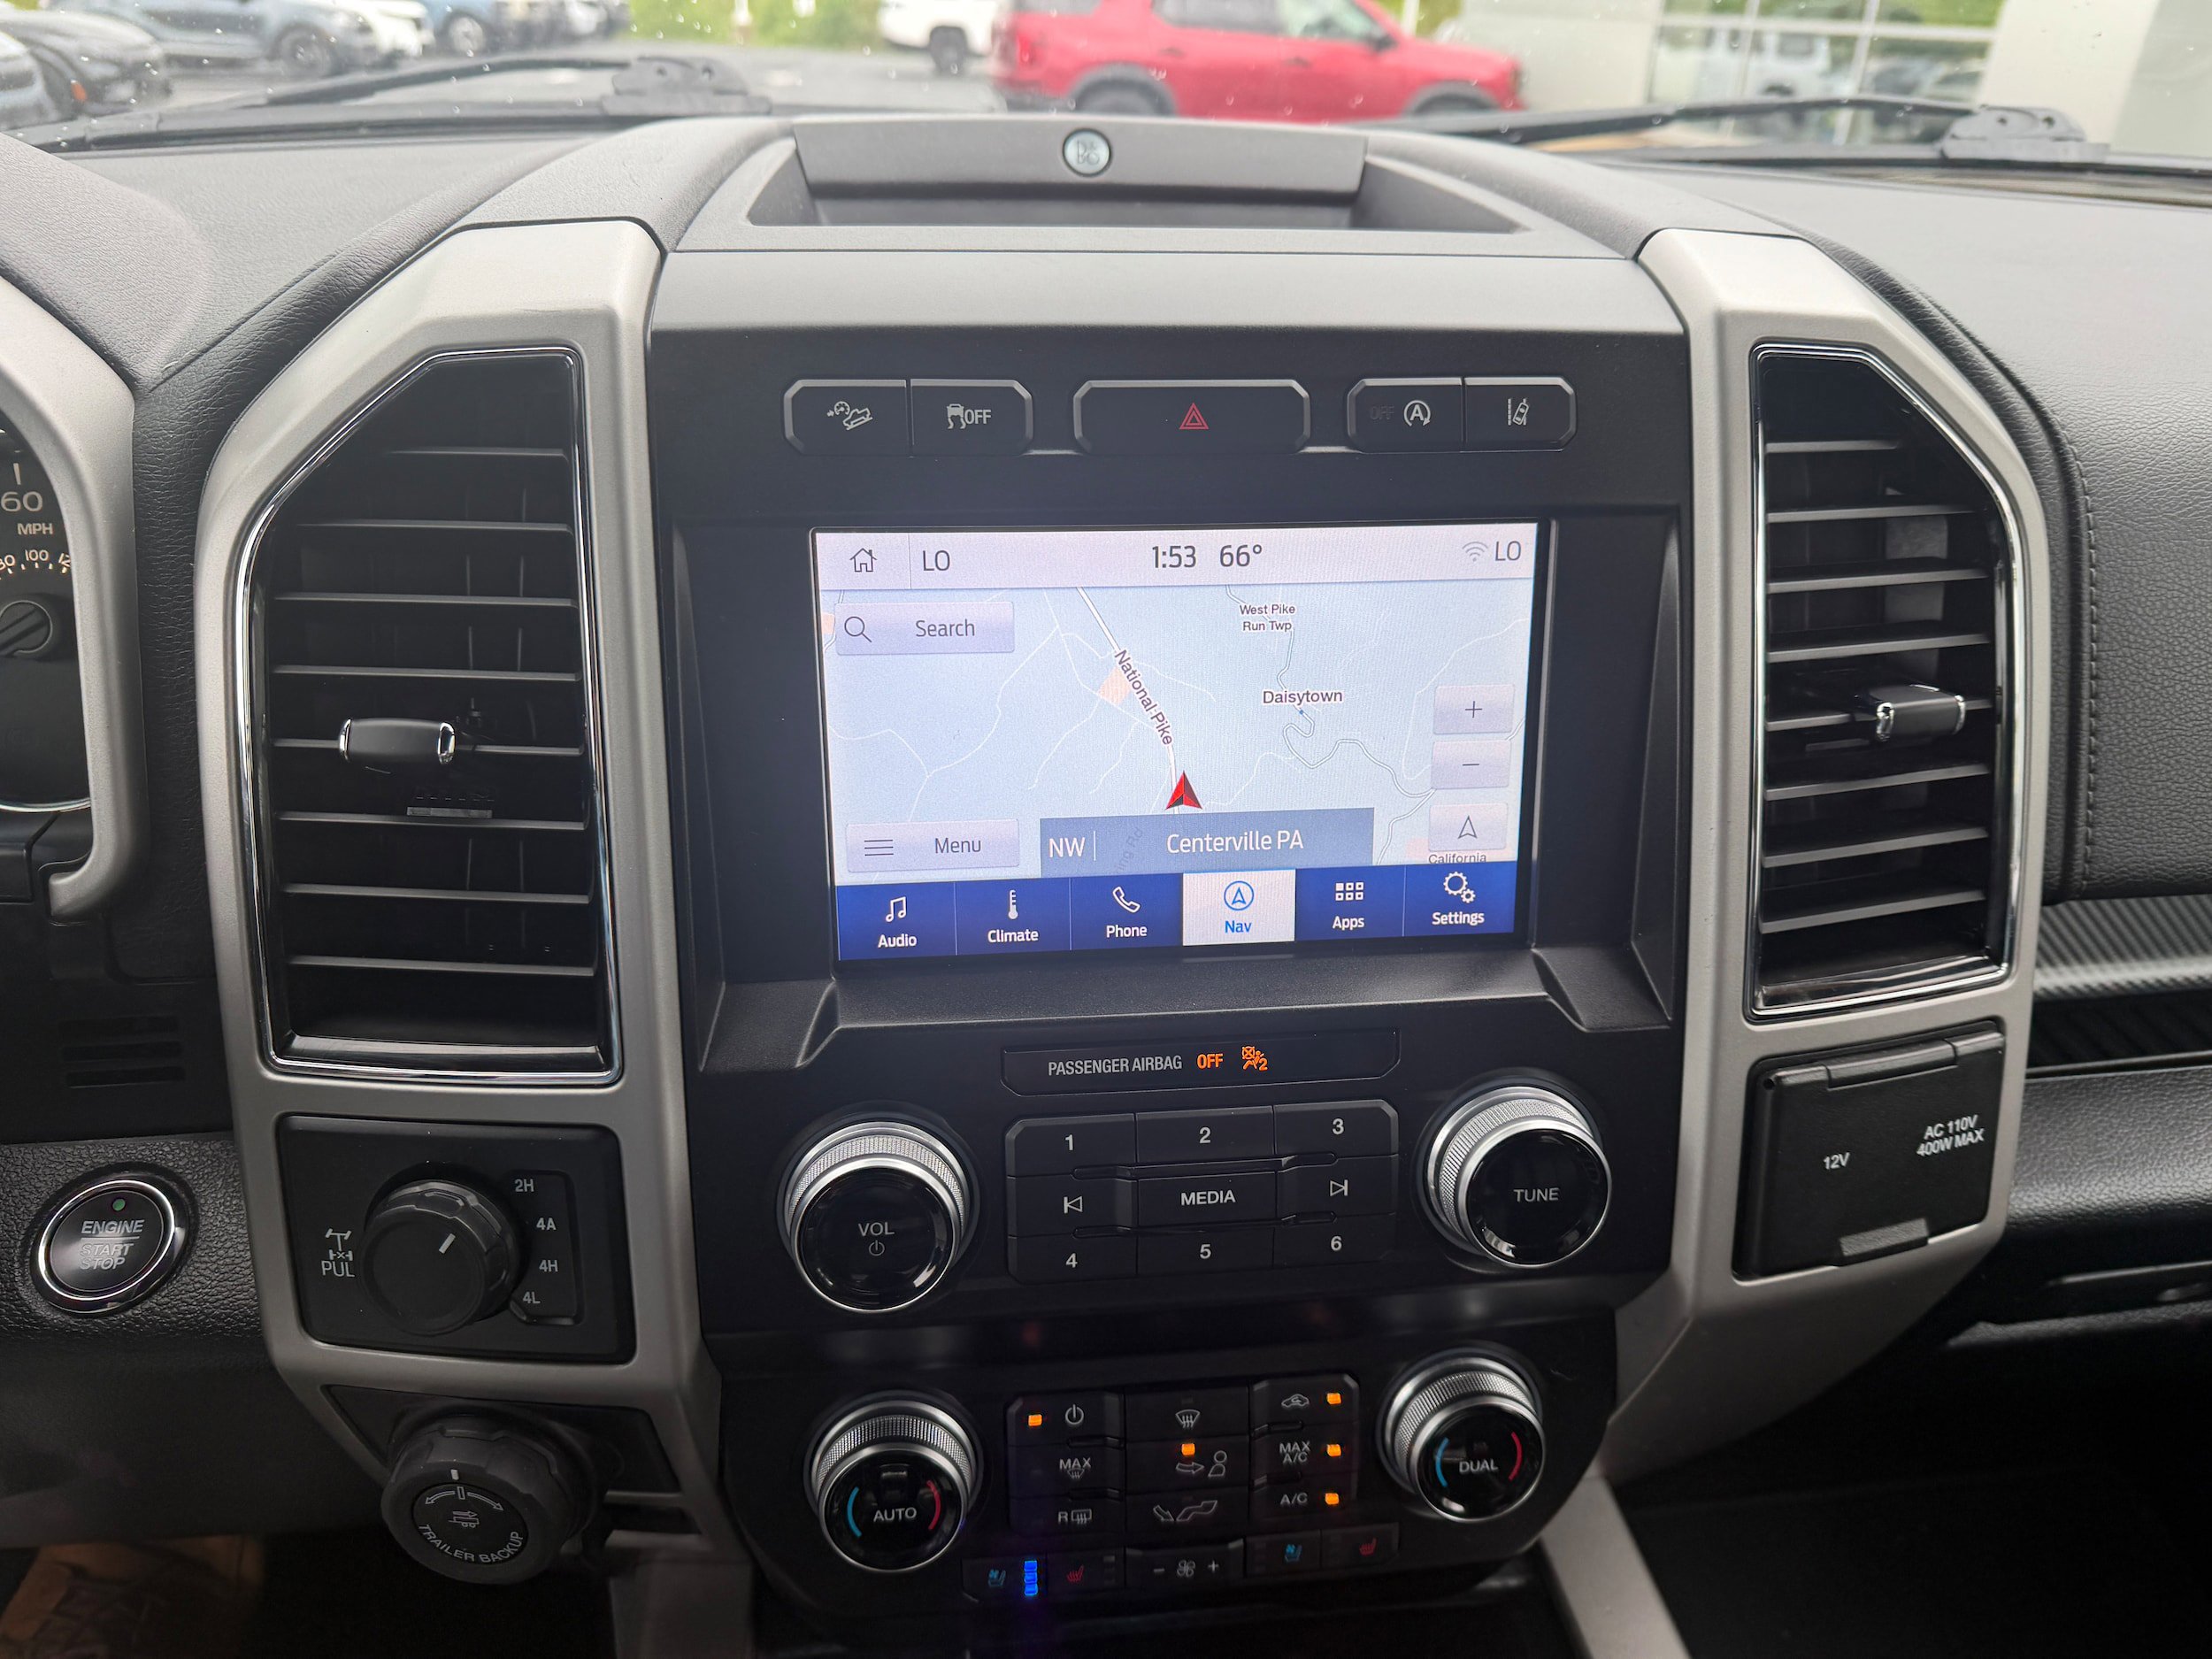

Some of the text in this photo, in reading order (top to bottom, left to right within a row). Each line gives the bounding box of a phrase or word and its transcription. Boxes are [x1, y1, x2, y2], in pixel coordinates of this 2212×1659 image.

[964, 409, 992, 425] OFF
[0, 490, 43, 512] 60
[17, 522, 54, 535] MPH
[25, 549, 50, 562] 100
[1152, 544, 1263, 569] 1:53 66°
[1494, 541, 1522, 562] LO
[922, 549, 951, 572] LO
[1239, 603, 1296, 615] West Pike
[916, 619, 975, 638] Search
[1242, 620, 1293, 632] Run Twp
[1114, 649, 1173, 745] National Pike
[1263, 689, 1343, 705] Daisytown
[934, 837, 982, 855] Menu
[1048, 837, 1086, 858] NW
[1166, 830, 1304, 853] Centerville PA
[1428, 852, 1487, 864] California
[1225, 919, 1252, 934] Nav
[1333, 915, 1365, 932] Apps
[1431, 910, 1486, 926] Settings
[987, 928, 1039, 944] Climate
[1106, 925, 1148, 939] Phone
[878, 933, 918, 949] Audio
[1048, 1055, 1183, 1077] PASSENGER AIRBAG
[1196, 1053, 1225, 1070] OFF
[1198, 1126, 1212, 1144] 2
[1332, 1118, 1345, 1135] 3
[1923, 1114, 1979, 1141] AC 110V
[1064, 1133, 1075, 1151] 1
[1916, 1127, 1985, 1157] 400W MAX
[1822, 1152, 1851, 1171] 12V
[514, 1178, 535, 1194] 2H
[1513, 1186, 1560, 1202] TUNE
[1180, 1188, 1237, 1207] MEDIA
[81, 1218, 145, 1235] ENGINE
[535, 1217, 557, 1232] 4A
[857, 1221, 896, 1238] VOL
[81, 1242, 134, 1257] START
[1199, 1243, 1212, 1260] 5
[1330, 1235, 1342, 1252] 6
[80, 1256, 127, 1271] STOP
[538, 1258, 559, 1273] 4H
[1065, 1252, 1079, 1268] 4
[321, 1260, 356, 1279] PUL
[523, 1291, 541, 1305] 4L
[1279, 1440, 1311, 1455] MAX
[1059, 1456, 1092, 1471] MAX
[1282, 1451, 1308, 1464] A/C
[1458, 1458, 1500, 1475] DUAL
[1279, 1492, 1309, 1506] A/C
[872, 1506, 918, 1523] AUTO
[1057, 1510, 1070, 1524] R
[418, 1524, 524, 1564] TRAILER BACKUP
